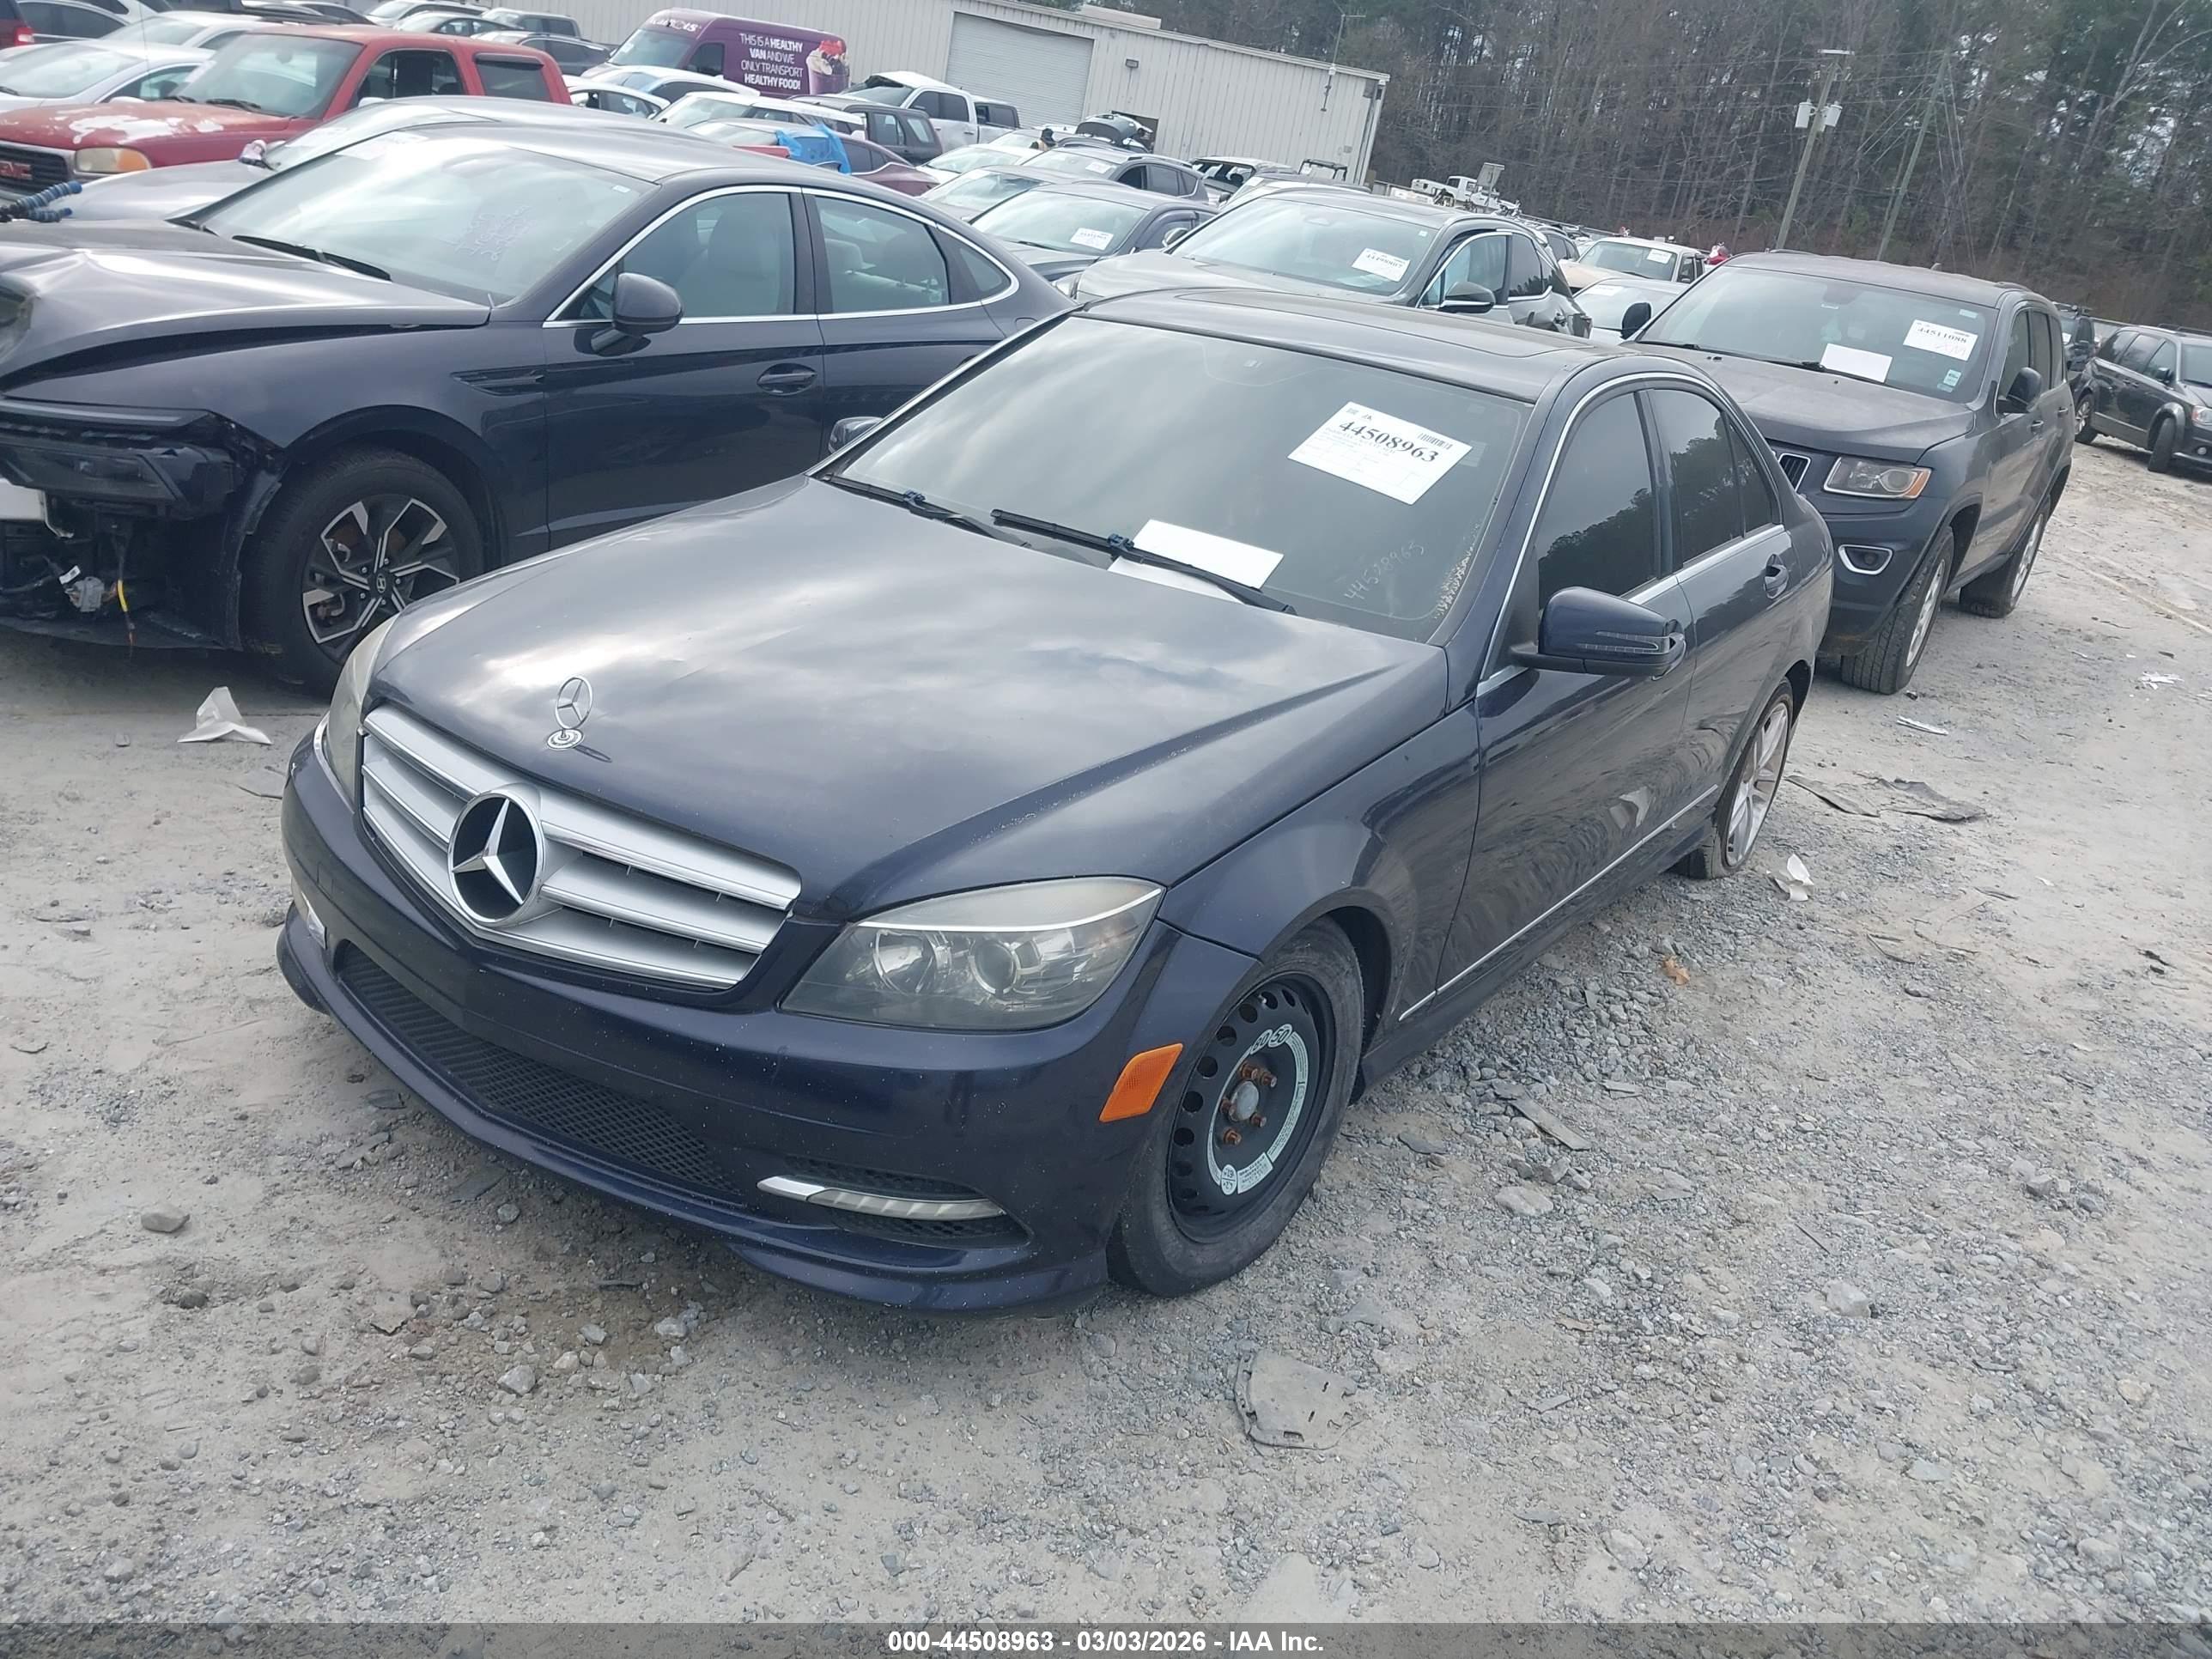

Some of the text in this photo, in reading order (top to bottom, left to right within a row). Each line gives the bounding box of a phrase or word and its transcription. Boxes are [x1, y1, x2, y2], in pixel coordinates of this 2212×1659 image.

[739, 33, 803, 52] THIS IS A HEALTHY
[750, 48, 794, 64] VAN AND WE
[741, 59, 804, 77] ONLY TRANSPORT
[744, 73, 801, 90] HEALTHY FOOD!
[1339, 421, 1439, 463] 44508963
[1270, 1028, 1291, 1043] 50
